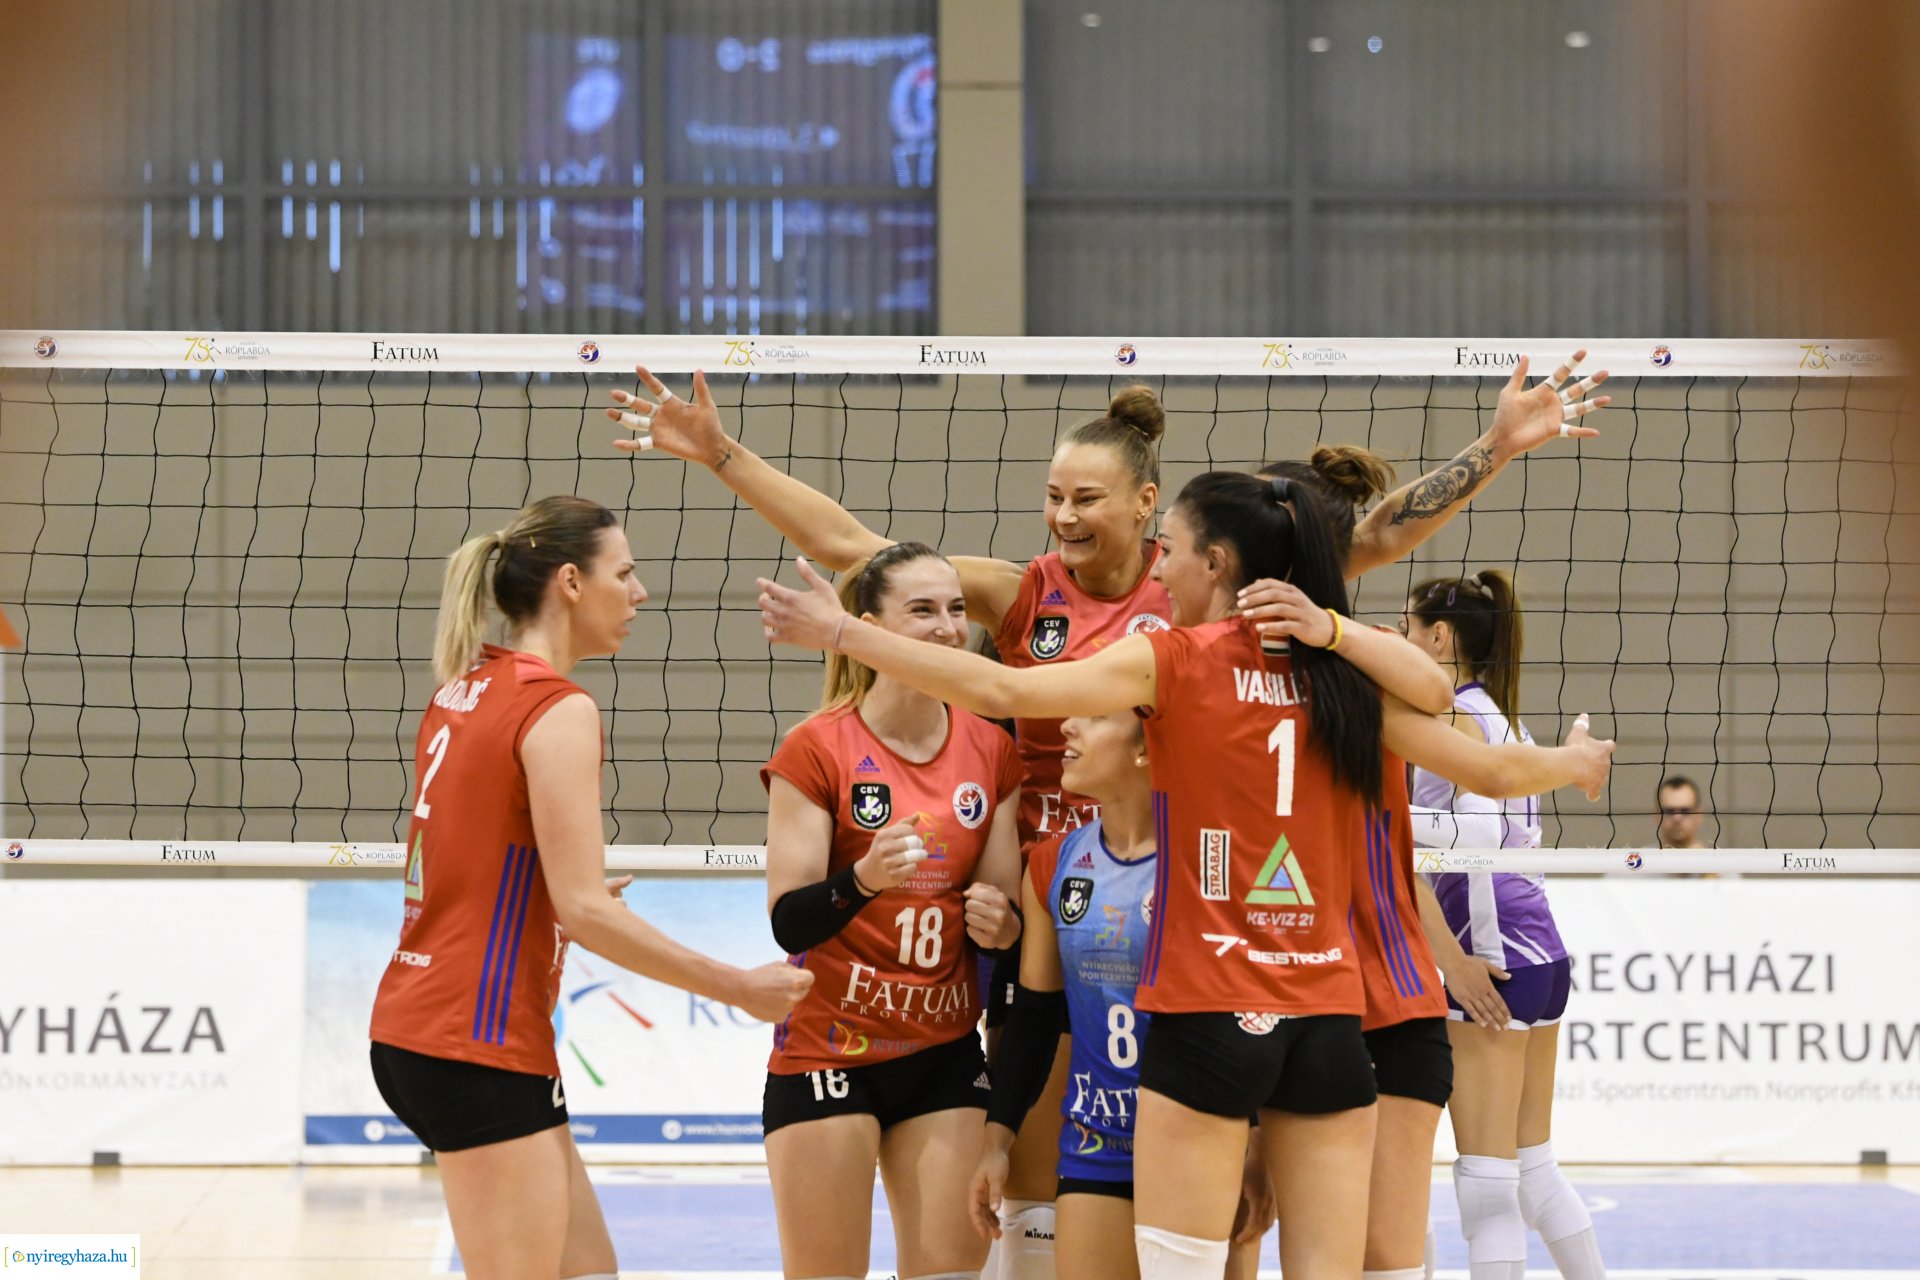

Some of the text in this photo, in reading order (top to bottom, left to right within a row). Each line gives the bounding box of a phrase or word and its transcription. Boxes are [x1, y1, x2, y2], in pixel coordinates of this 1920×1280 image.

[372, 340, 439, 360] FATUM
[919, 344, 986, 364] FATUM
[1044, 619, 1061, 629] CEV
[414, 723, 451, 820] 2
[1268, 718, 1296, 816] 1
[860, 786, 880, 795] CEV
[161, 845, 216, 861] FATUM
[704, 849, 758, 865] FATUM
[1782, 853, 1836, 868] FATUM
[1210, 833, 1221, 896] STRABAG
[1070, 880, 1086, 889] CEV
[1247, 911, 1314, 927] KE-VIZ 21
[895, 906, 943, 969] 18
[1247, 948, 1343, 965] BESTRONG
[841, 961, 970, 1014] FATUM
[1106, 1003, 1139, 1069] 8
